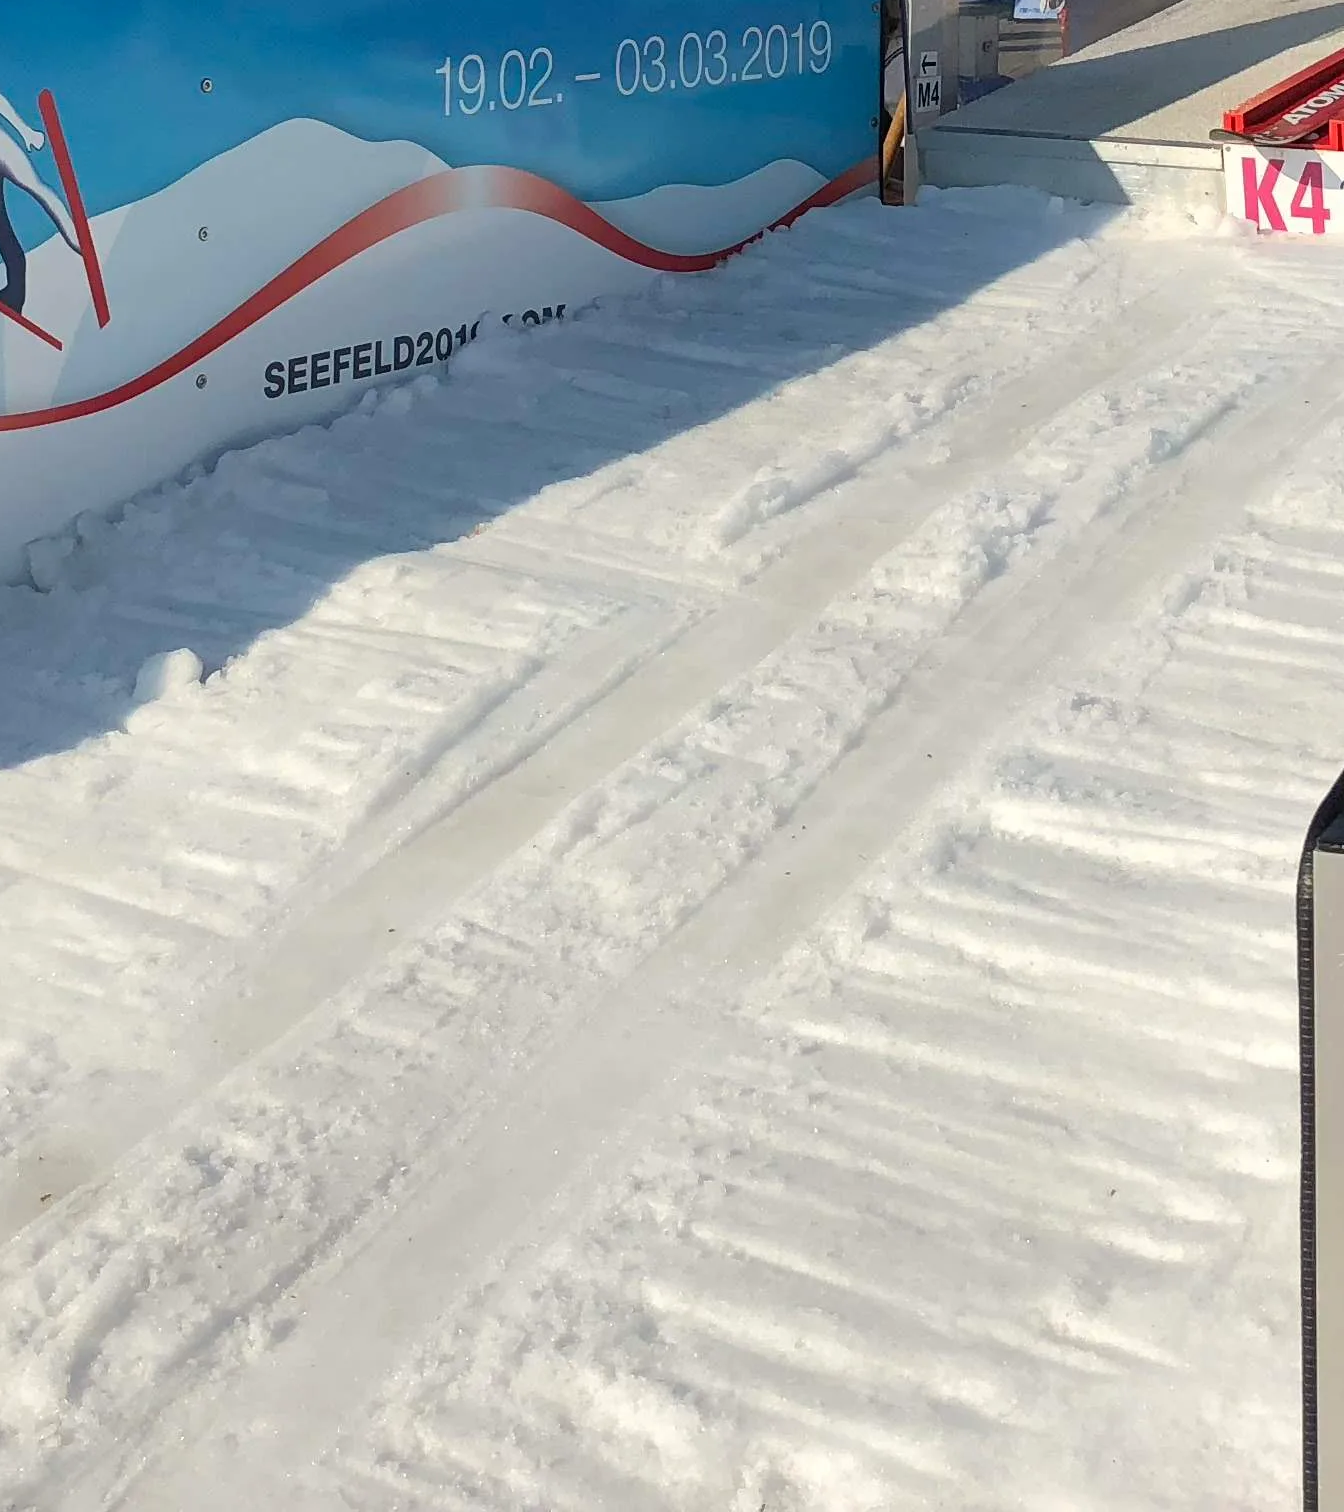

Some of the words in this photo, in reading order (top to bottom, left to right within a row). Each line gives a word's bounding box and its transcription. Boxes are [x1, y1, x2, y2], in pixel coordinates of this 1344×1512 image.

[434, 46, 564, 116] 19.02.
[614, 20, 833, 97] 03.03.2019
[918, 80, 940, 108] M4
[1241, 157, 1331, 235] K4
